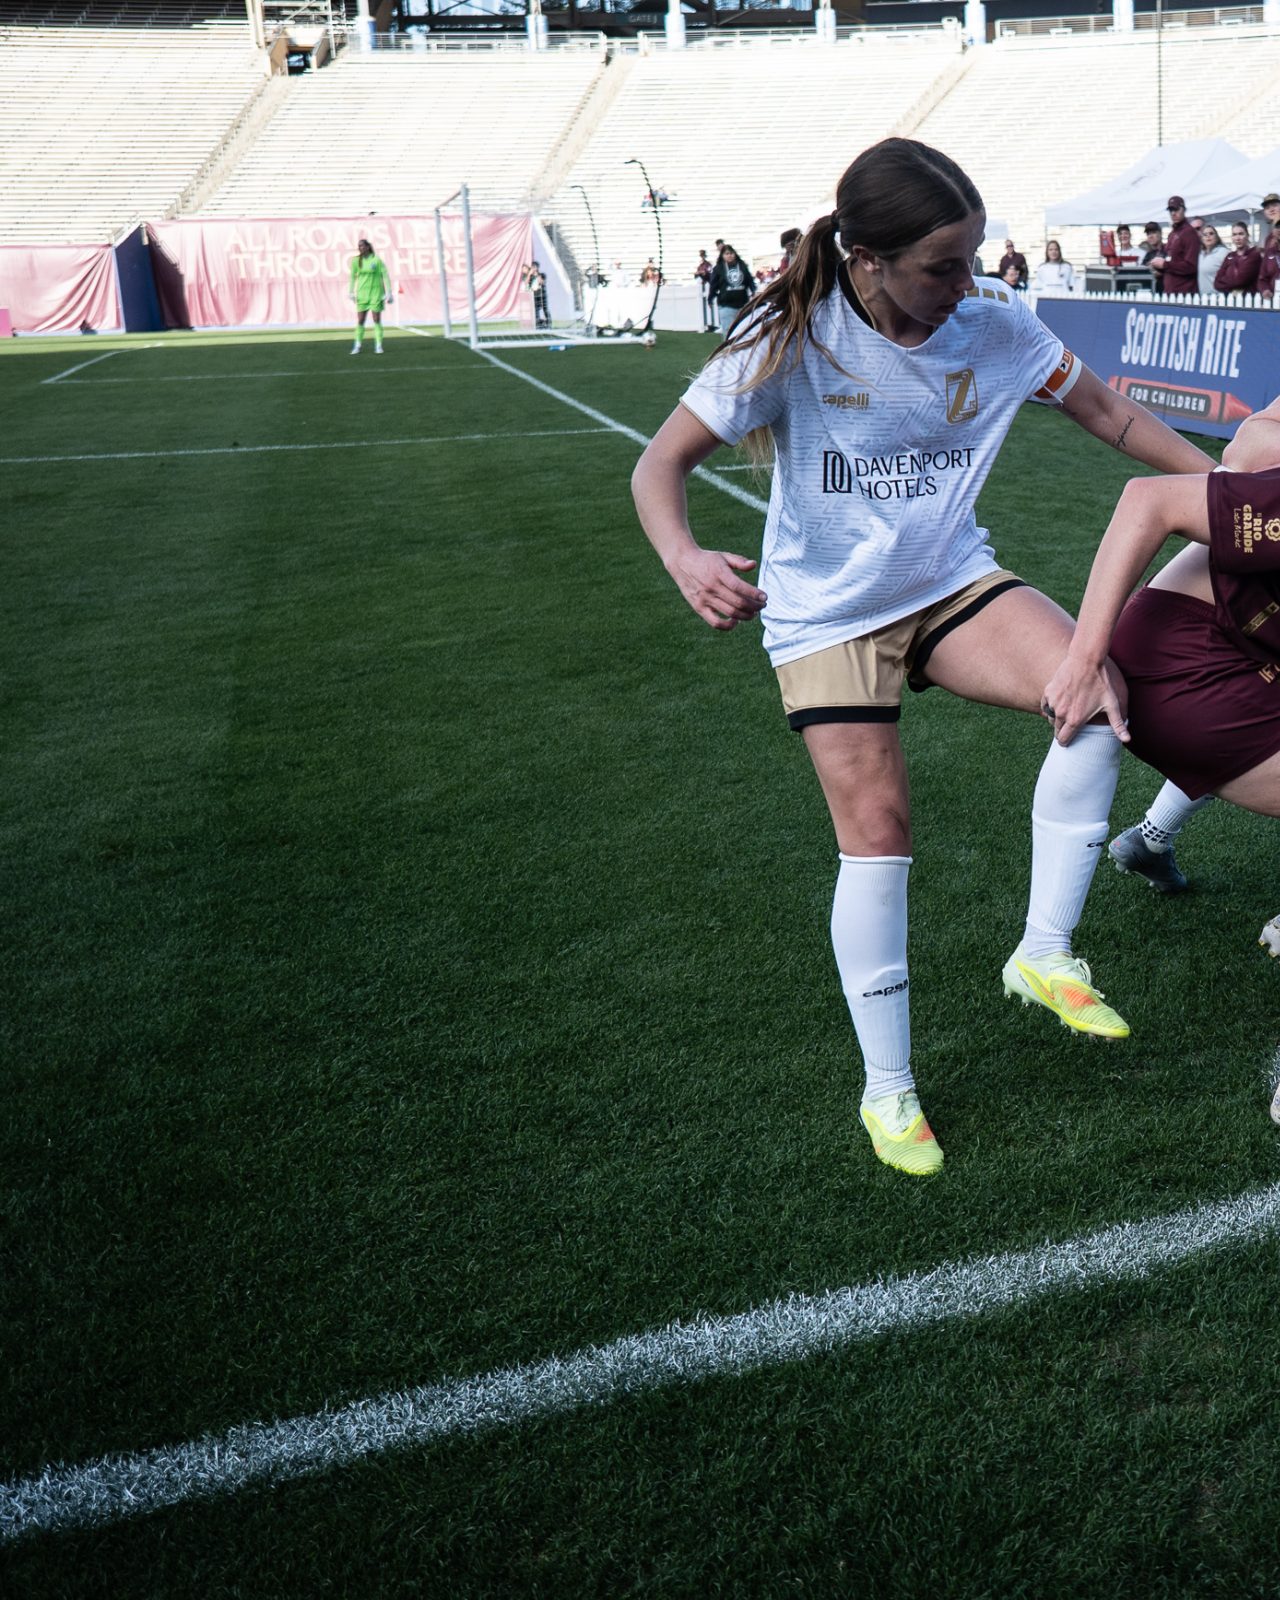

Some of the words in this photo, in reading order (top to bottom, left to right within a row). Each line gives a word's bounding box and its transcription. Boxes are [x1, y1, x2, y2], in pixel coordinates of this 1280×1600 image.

[225, 227, 284, 252] ALL
[289, 224, 392, 250] ROADS
[1120, 307, 1202, 373] SCOTTISH
[1198, 313, 1247, 379] RITE
[822, 392, 870, 408] capelli
[1129, 387, 1148, 402] FOR
[1151, 391, 1206, 413] CHILDREN
[854, 447, 976, 477] DAVENPORT
[857, 475, 938, 500] HOTELS
[1243, 504, 1253, 553] GRANDE
[1253, 518, 1263, 541] RIO
